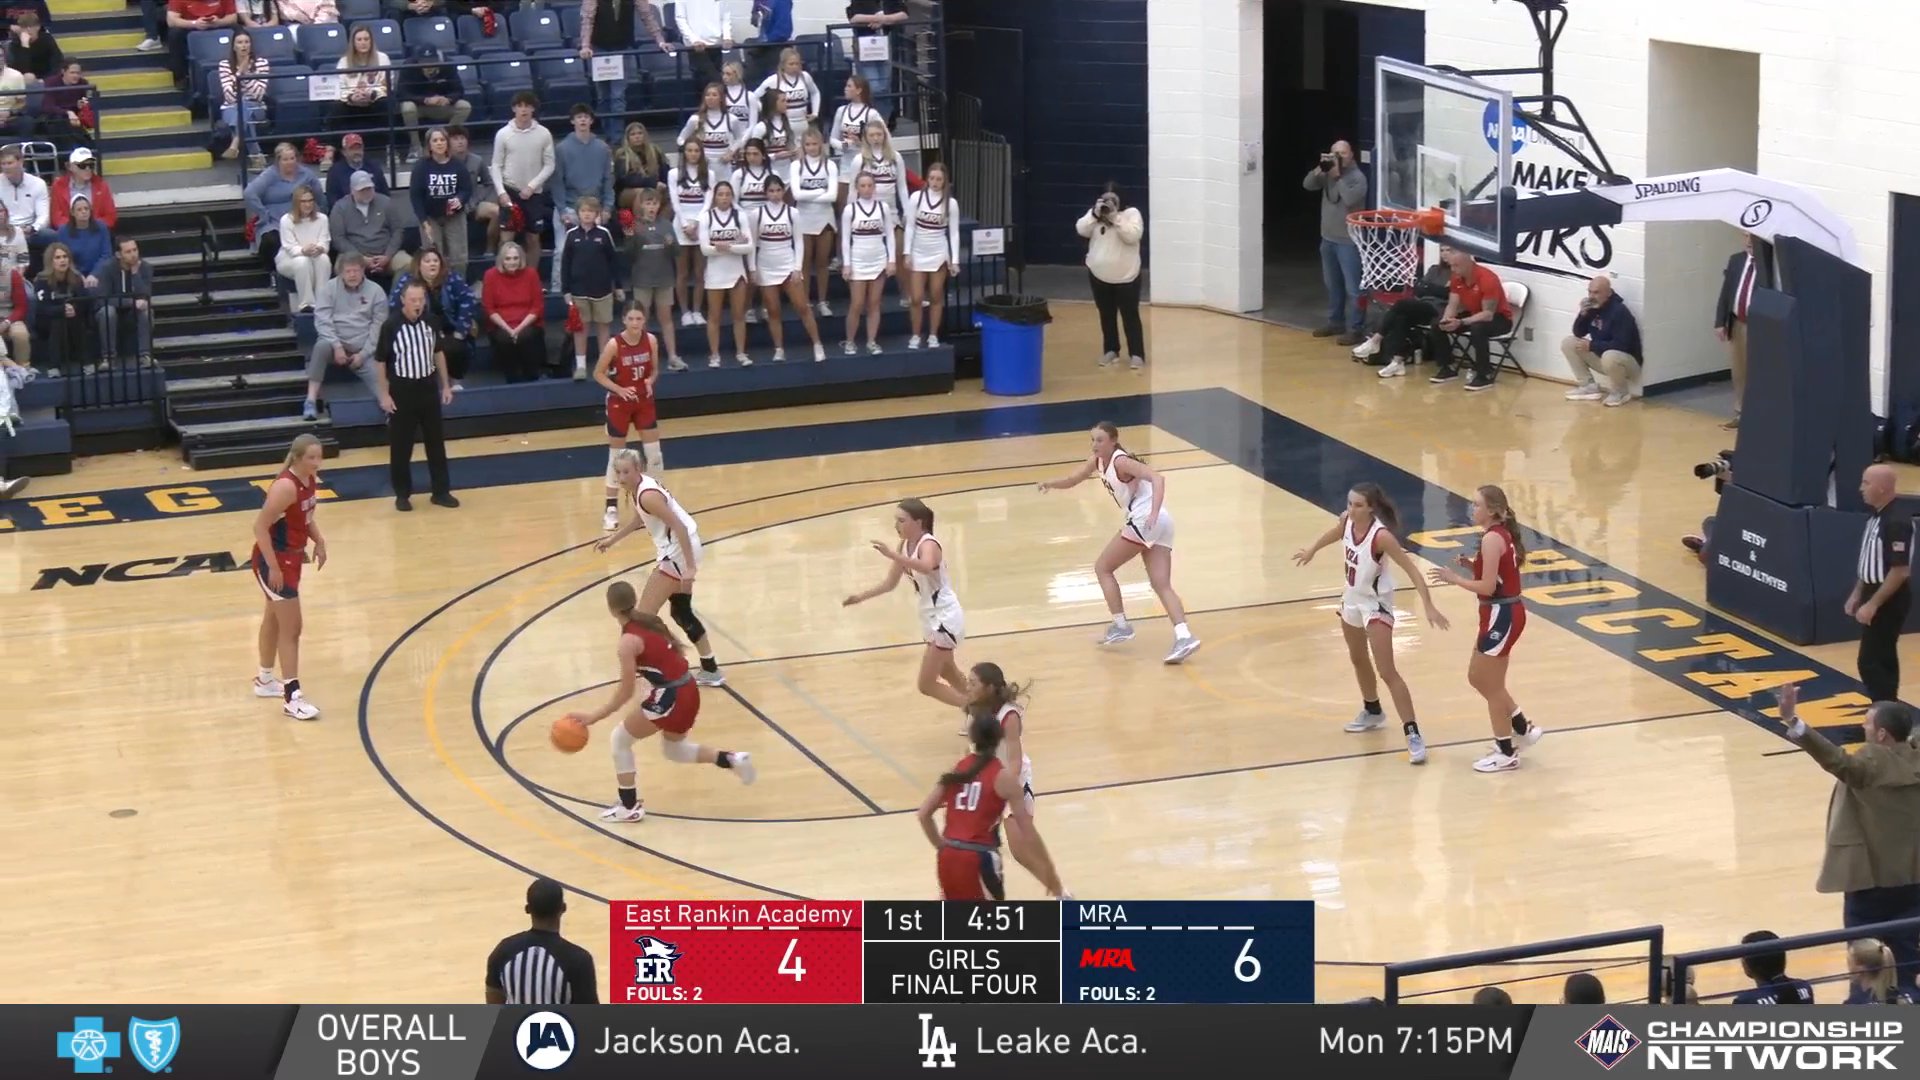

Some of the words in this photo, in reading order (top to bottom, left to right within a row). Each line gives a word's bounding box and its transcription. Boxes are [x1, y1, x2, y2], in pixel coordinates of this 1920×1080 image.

[429, 173, 458, 185] PATS
[1513, 160, 1590, 191] MAKE
[1635, 177, 1700, 199] SPALDING
[1742, 529, 1767, 548] BETSY
[1750, 550, 1757, 562] &
[1718, 554, 1731, 568] DR.
[1732, 560, 1752, 576] CHAD
[1752, 568, 1788, 592] ALTMYER
[955, 781, 982, 811] 20
